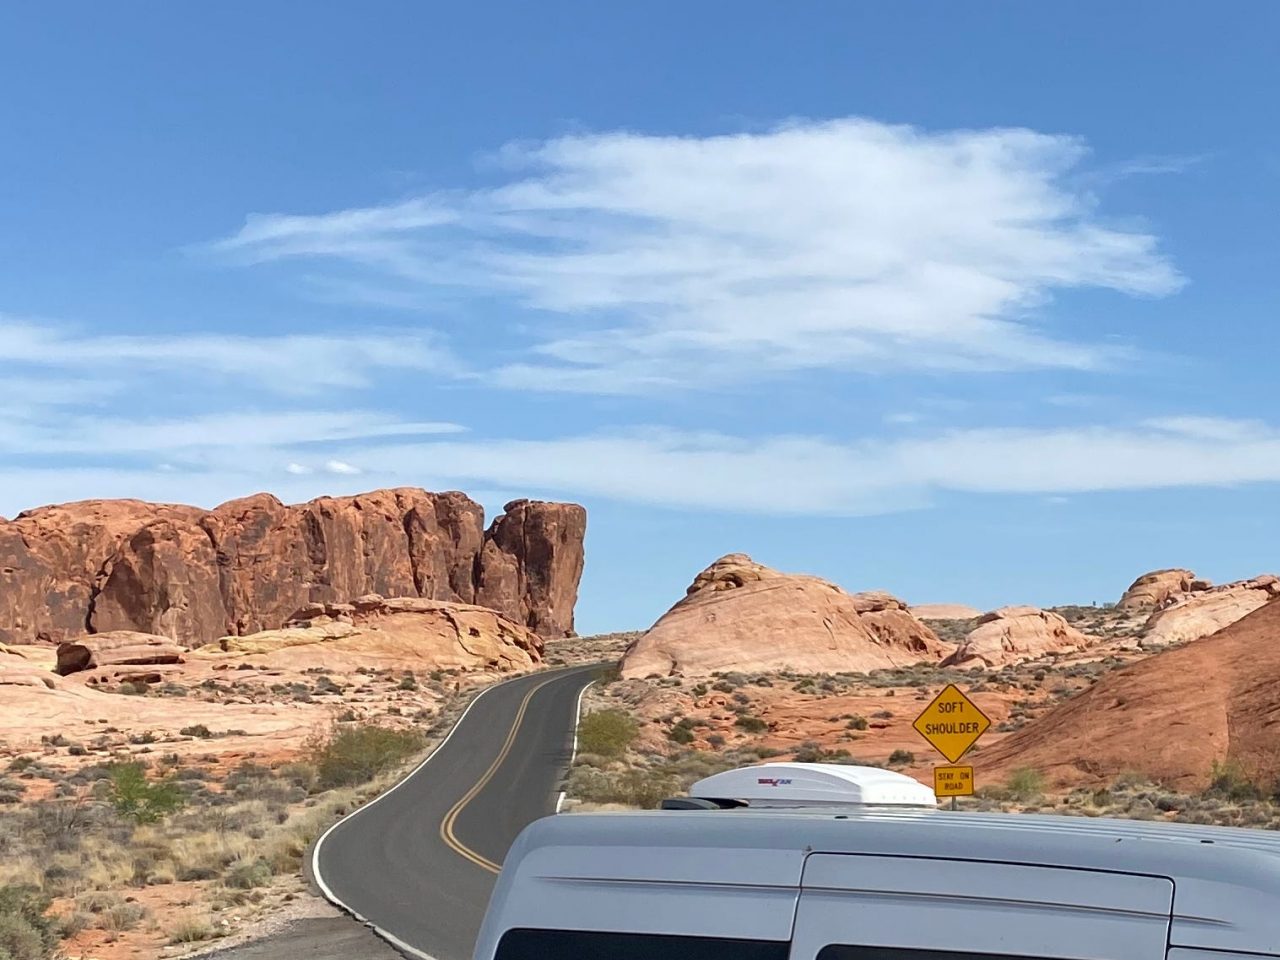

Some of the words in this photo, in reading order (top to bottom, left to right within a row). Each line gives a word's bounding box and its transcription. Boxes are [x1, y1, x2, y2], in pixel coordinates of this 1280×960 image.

[938, 702, 964, 713] SOFT
[925, 722, 980, 735] SHOULDER
[960, 772, 970, 780] ON
[944, 782, 963, 790] ROAD
